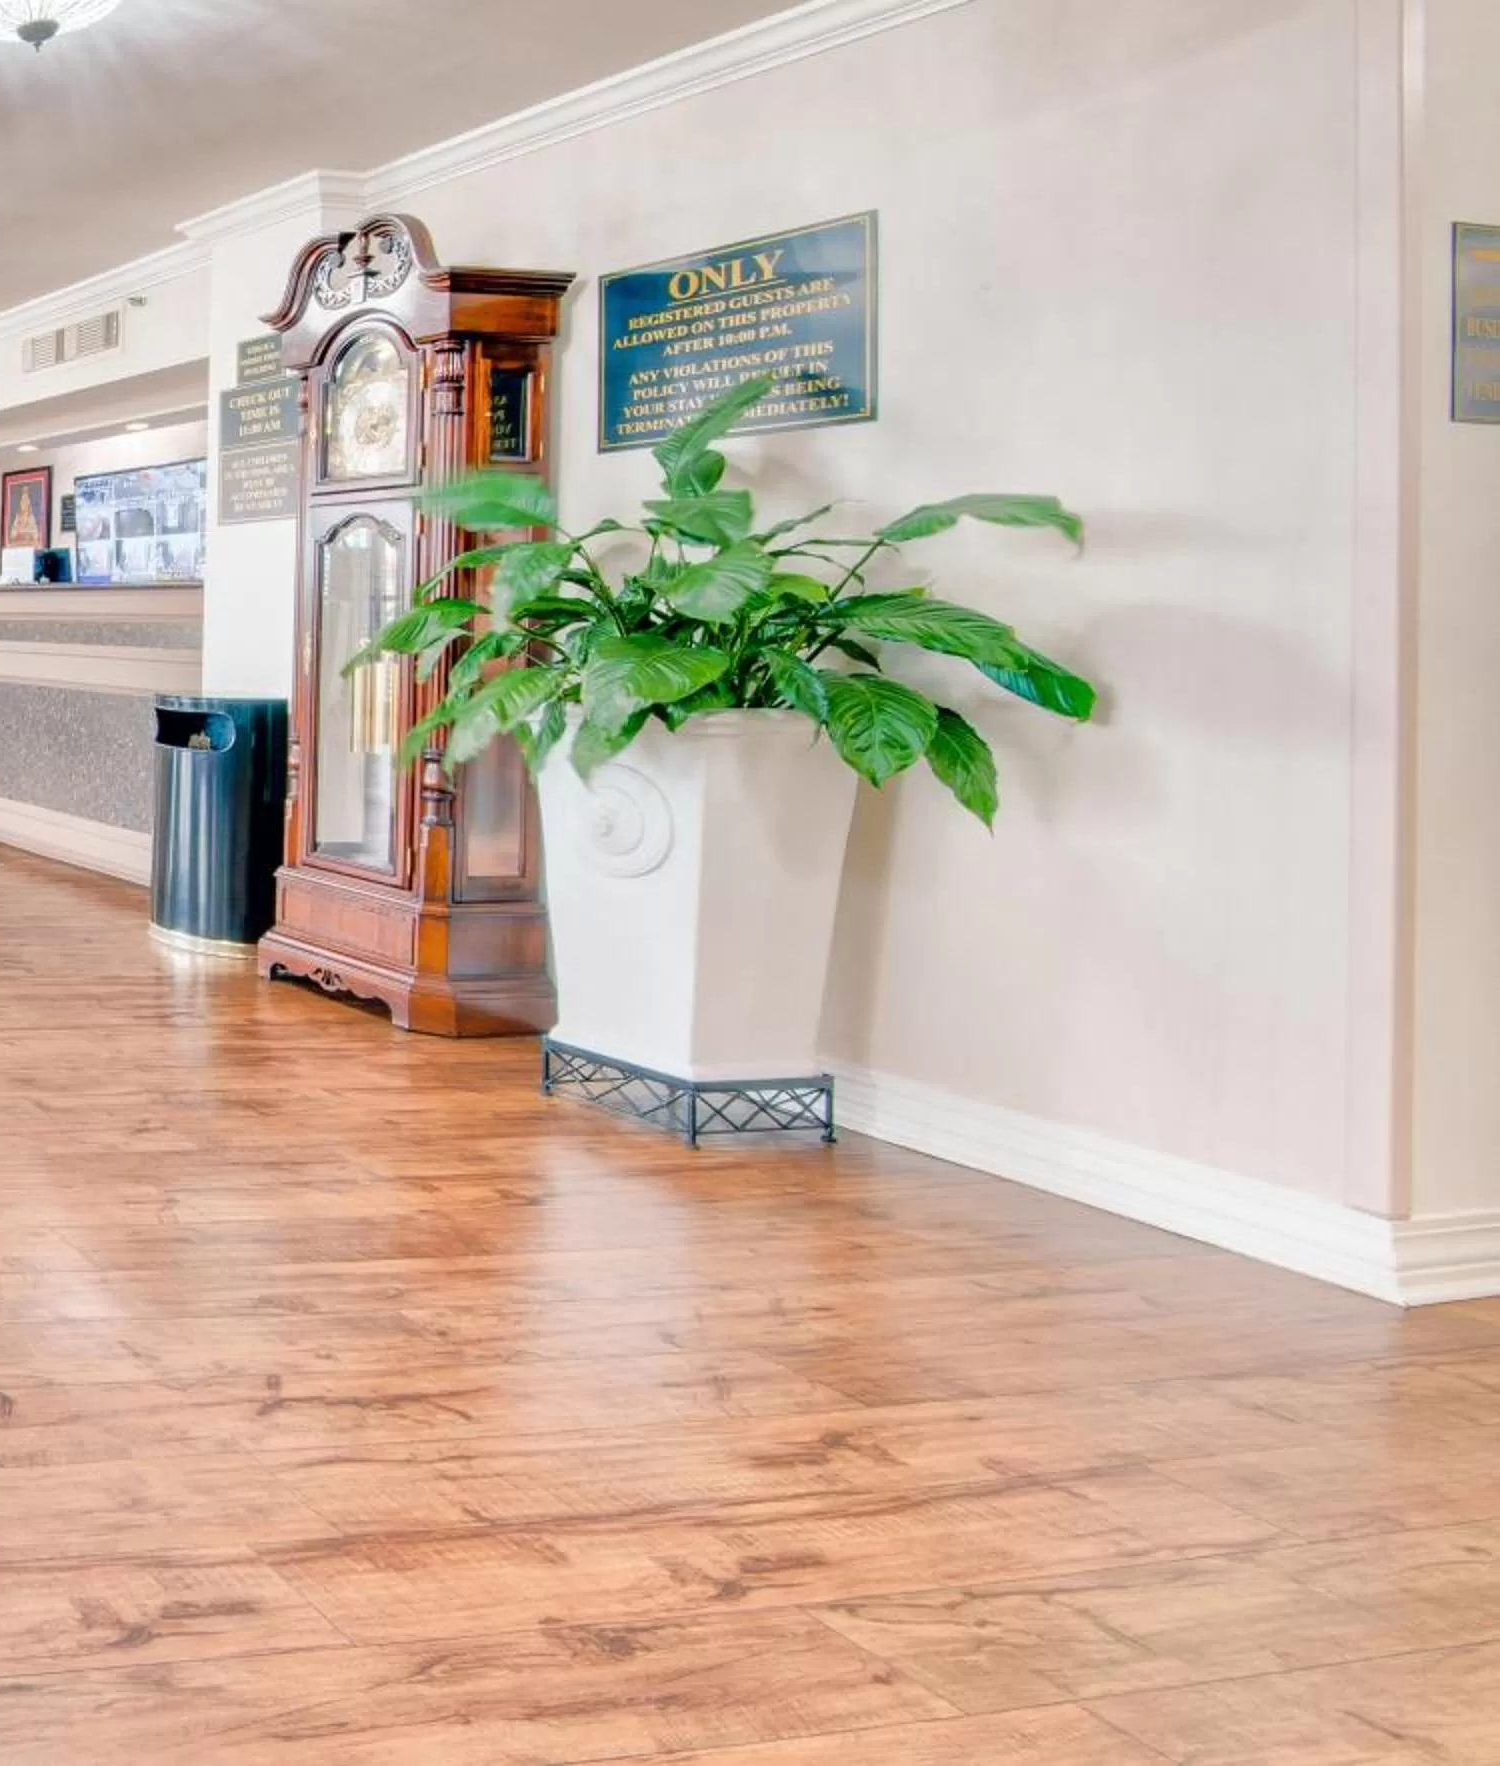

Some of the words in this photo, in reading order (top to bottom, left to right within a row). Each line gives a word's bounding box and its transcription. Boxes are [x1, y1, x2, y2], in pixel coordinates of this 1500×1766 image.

[669, 249, 785, 300] ONLY
[613, 325, 689, 350] ALLOWED
[691, 319, 715, 335] ON
[718, 311, 757, 329] THIS
[760, 292, 851, 321] PROPERTY
[627, 300, 726, 330] REGISTERED
[729, 286, 795, 309] GUESTS
[797, 277, 836, 297] ARE
[663, 337, 714, 356] AFTER
[759, 323, 793, 339] P.M.
[629, 369, 660, 388] ANY
[663, 353, 762, 379] VIOLATIONS
[764, 348, 789, 363] OF
[794, 340, 834, 359] THIS
[633, 381, 689, 400] POLICY
[692, 374, 734, 391] WILL
[809, 359, 830, 375] IN
[623, 401, 666, 418] YOUR
[667, 396, 704, 412] STAY
[784, 375, 841, 396] BEING
